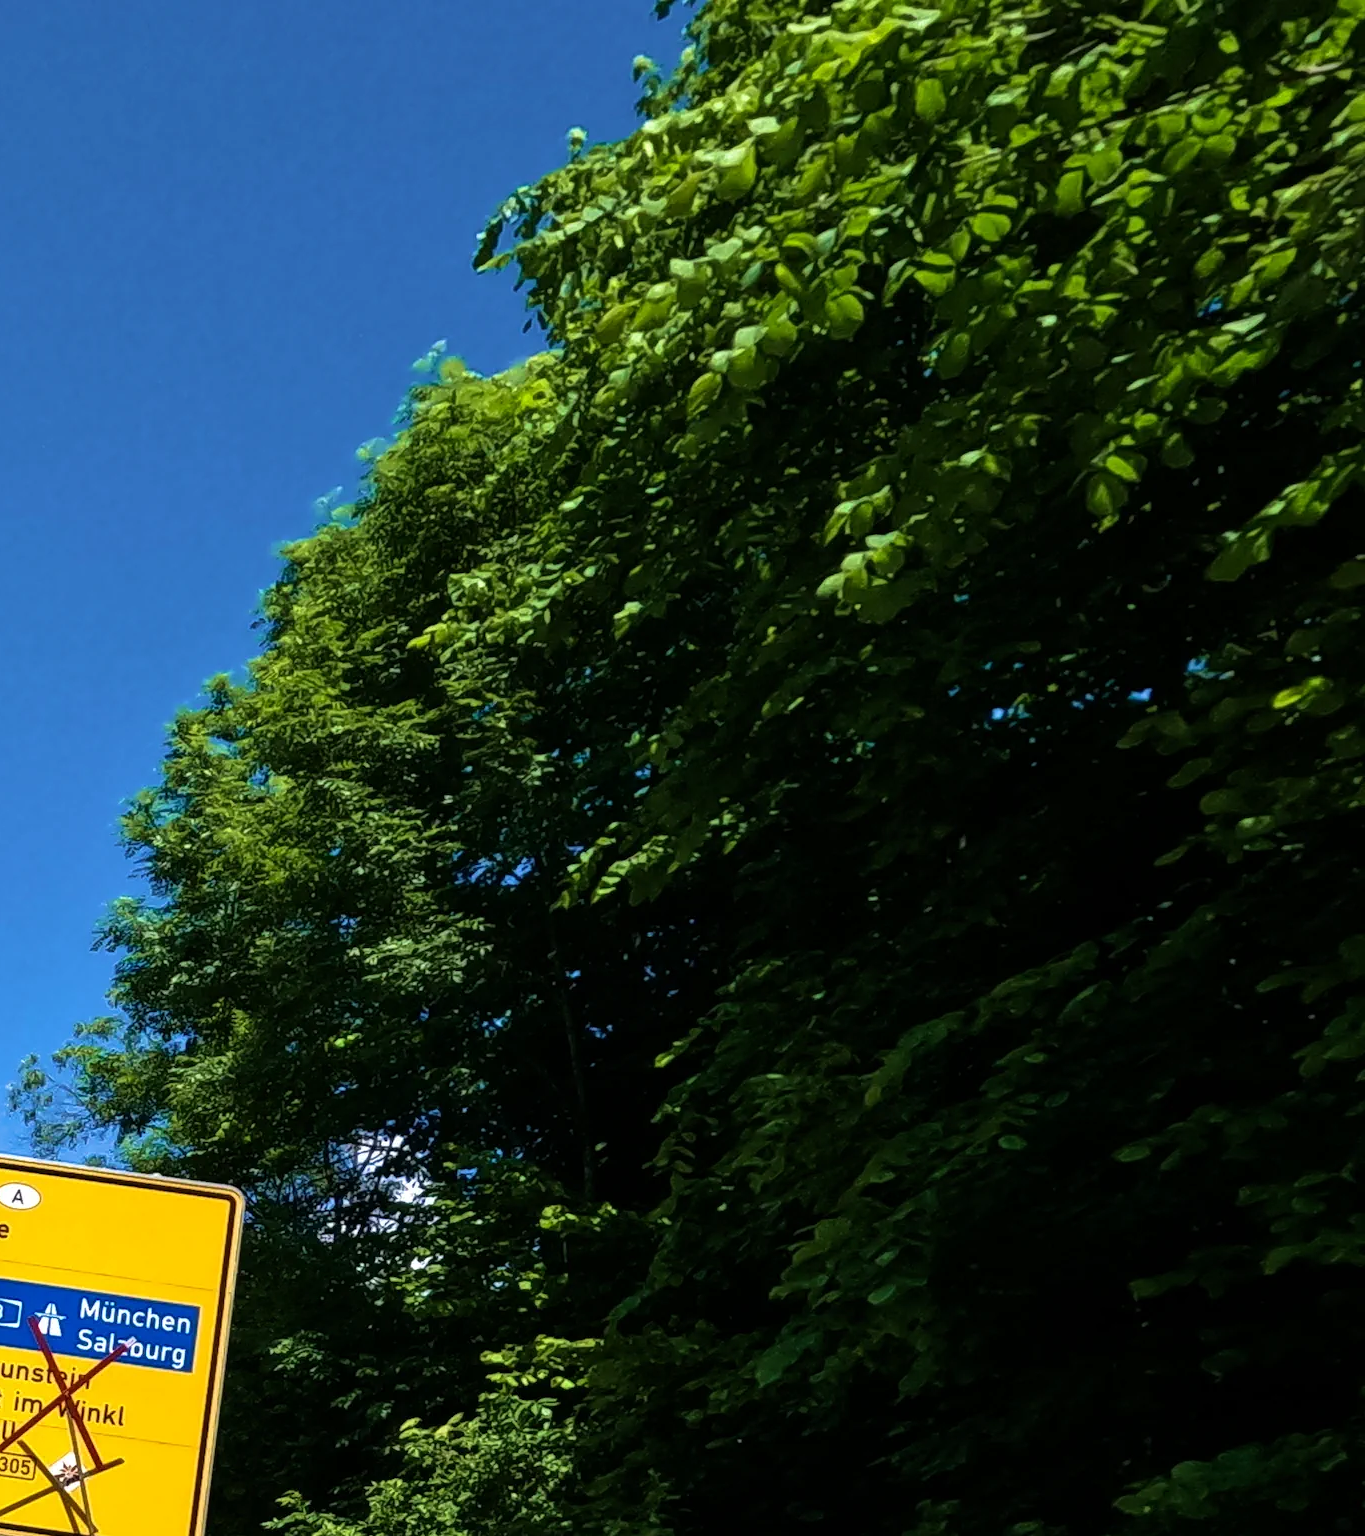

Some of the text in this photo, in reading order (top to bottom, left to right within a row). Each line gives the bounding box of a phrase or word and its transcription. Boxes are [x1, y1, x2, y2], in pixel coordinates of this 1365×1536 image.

[12, 1189, 24, 1205] A
[79, 1298, 191, 1335] München
[14, 1391, 43, 1414] im
